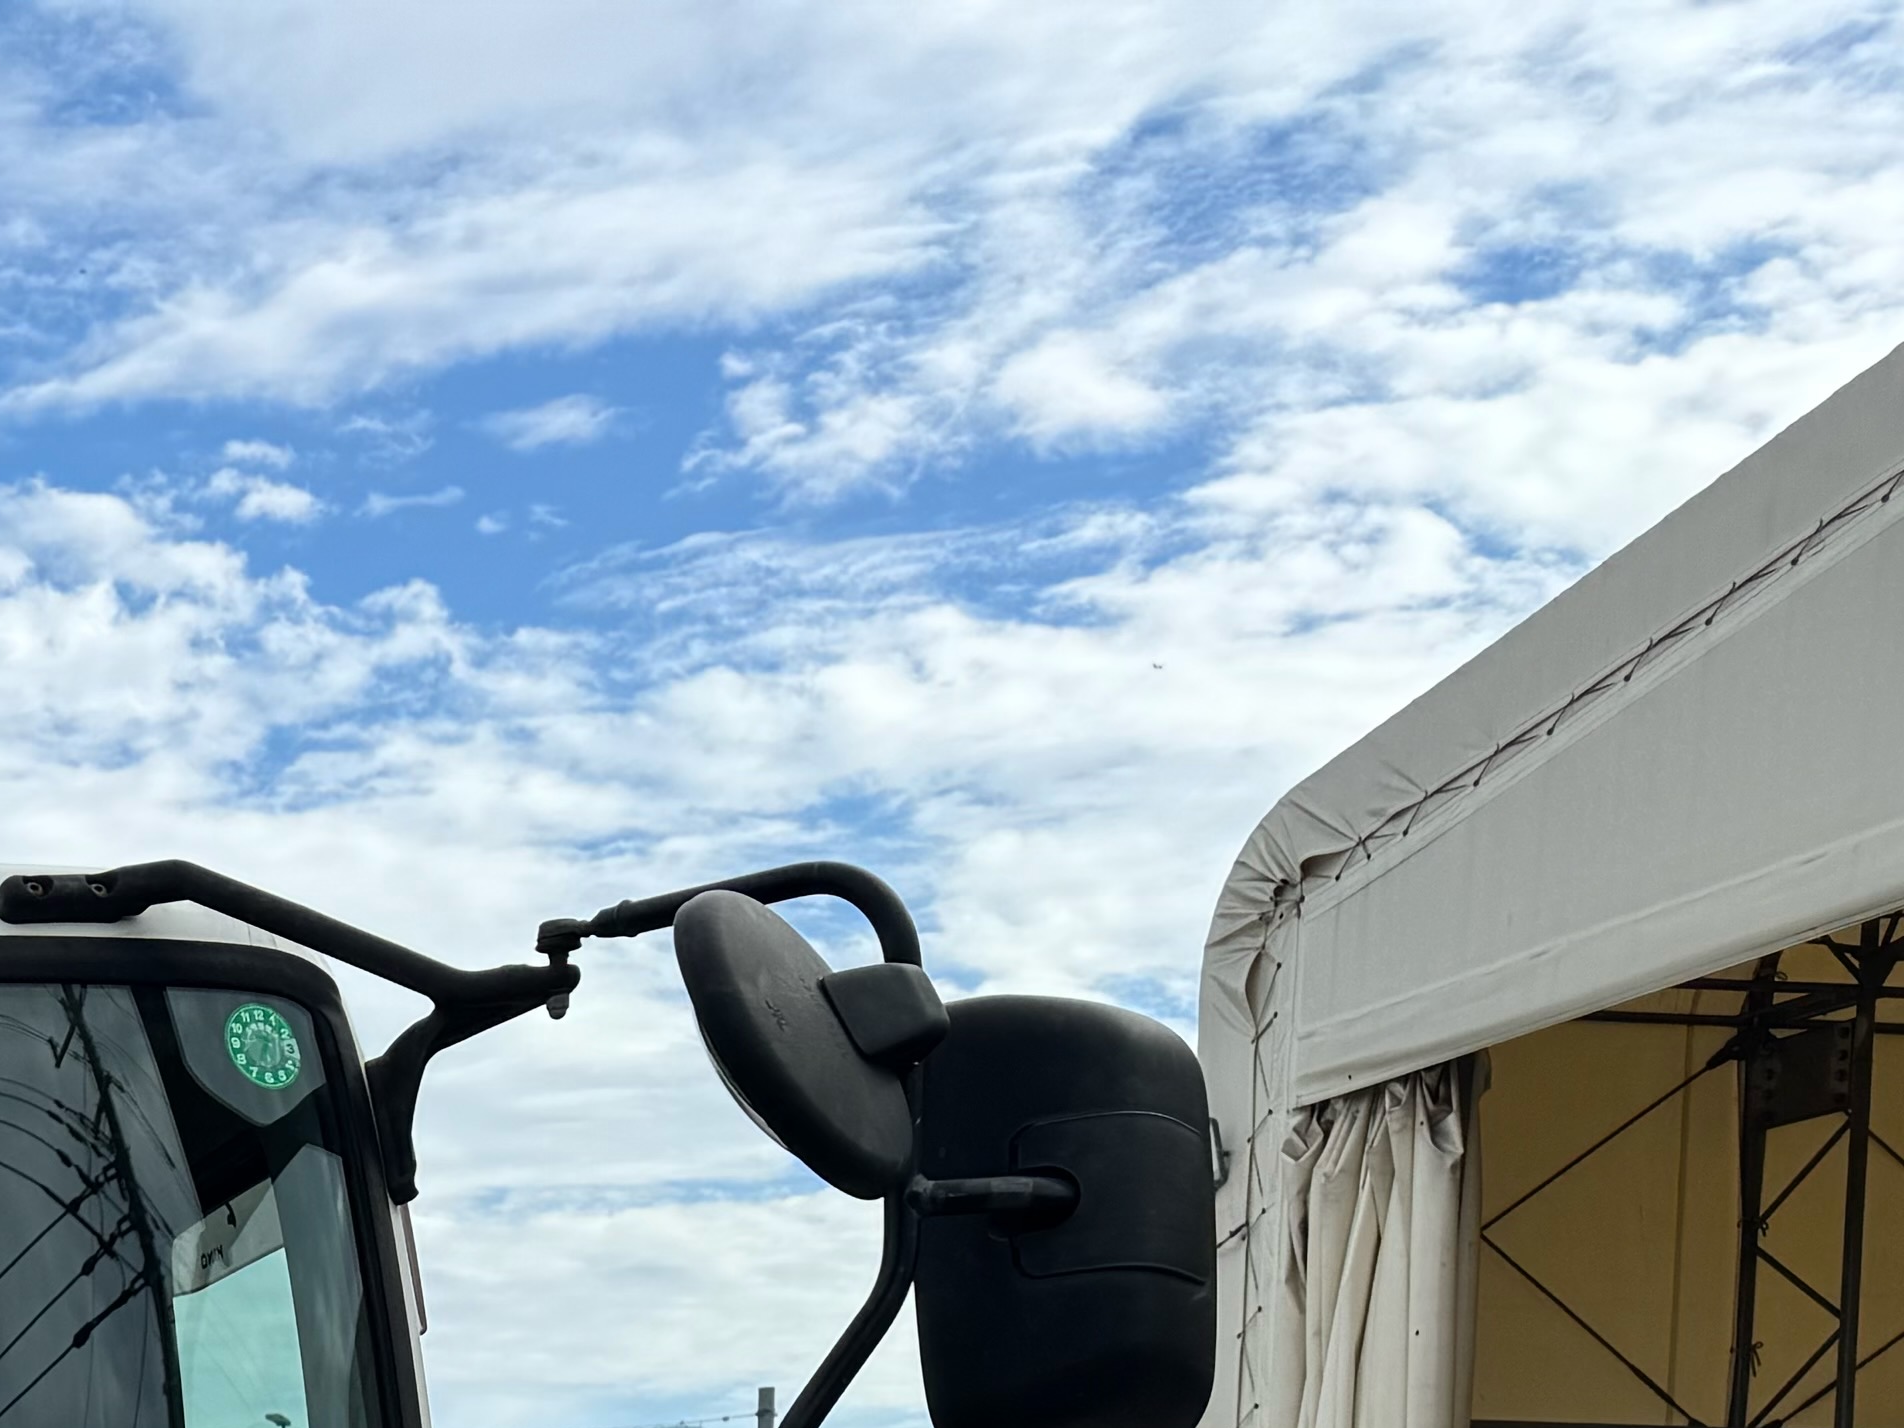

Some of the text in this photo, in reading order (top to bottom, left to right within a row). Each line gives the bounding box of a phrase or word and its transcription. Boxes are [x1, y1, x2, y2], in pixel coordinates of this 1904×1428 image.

[240, 1011, 251, 1023] 11
[253, 1009, 265, 1021] 12
[231, 1022, 243, 1034] 10
[280, 1028, 290, 1040] 2
[230, 1037, 241, 1049] 9
[285, 1043, 295, 1055] 3
[236, 1053, 247, 1065] 8
[249, 1066, 259, 1078] 7
[264, 1072, 275, 1084] 6
